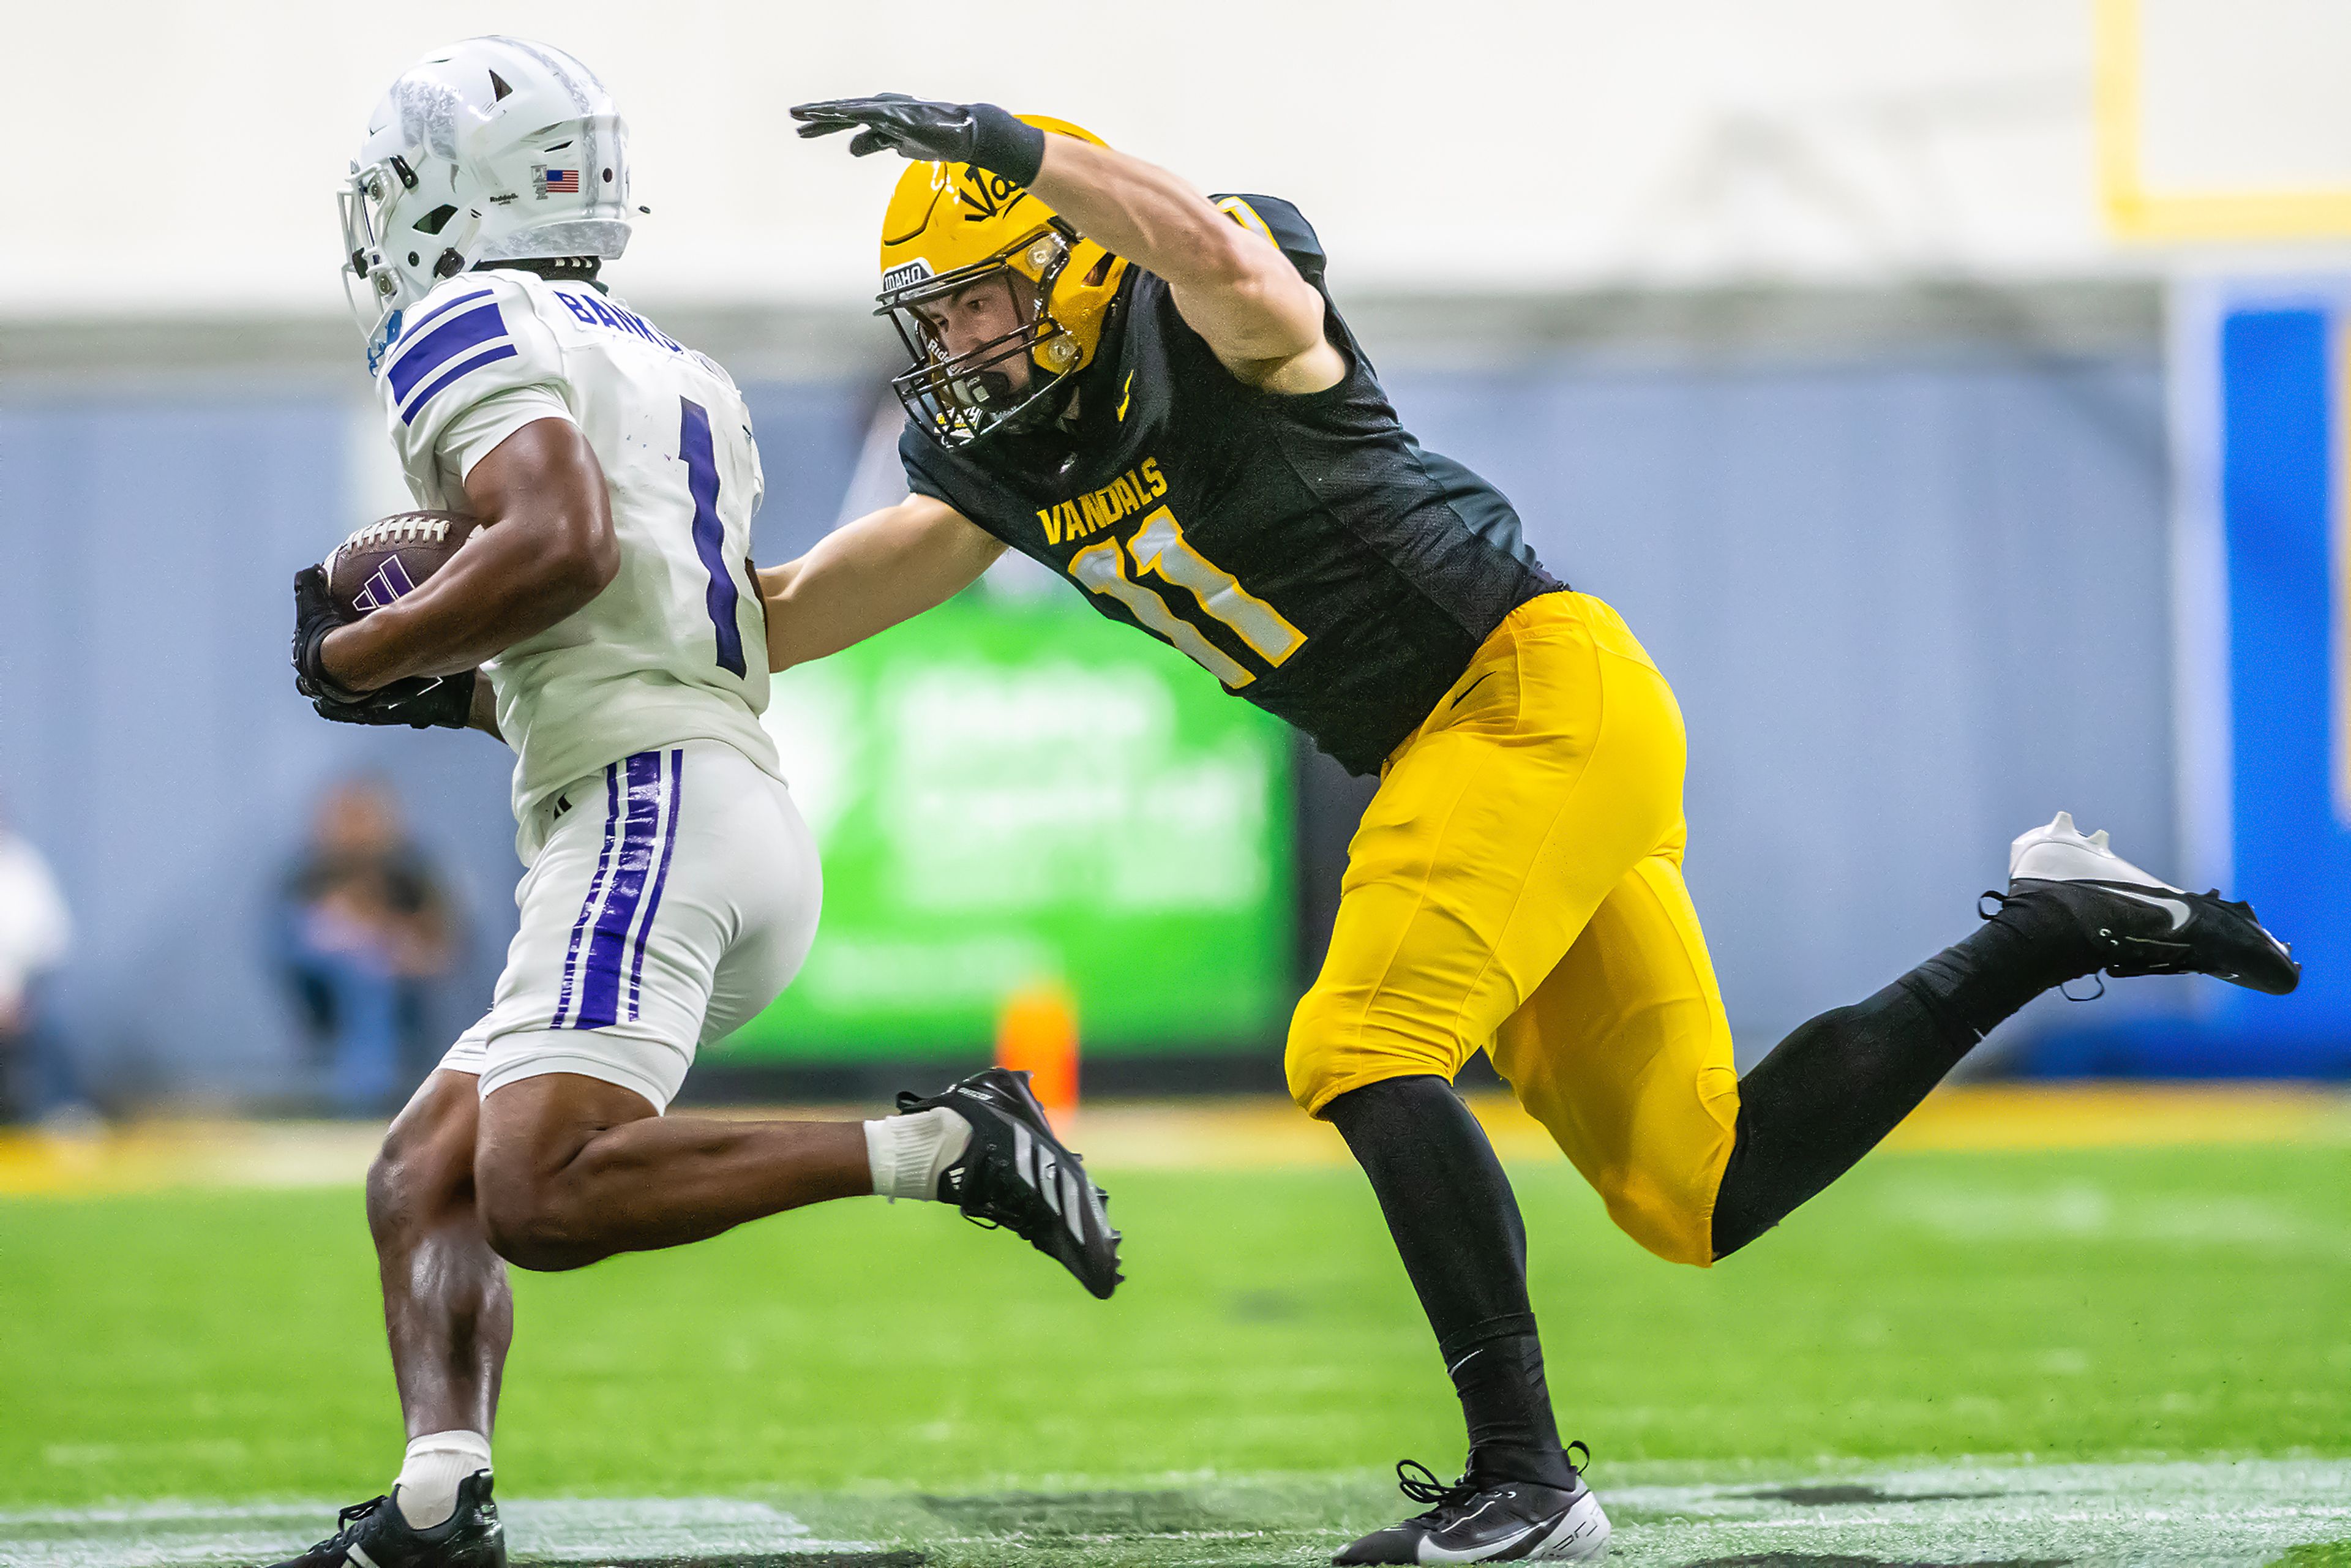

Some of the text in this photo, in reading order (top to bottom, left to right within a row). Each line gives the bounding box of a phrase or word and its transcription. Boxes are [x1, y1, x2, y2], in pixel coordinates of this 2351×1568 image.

[553, 290, 684, 354] BANKS
[885, 266, 921, 291] IDAHO
[678, 394, 747, 681] 1
[1037, 456, 1168, 546] VANDALS
[1068, 505, 1308, 689] 11
